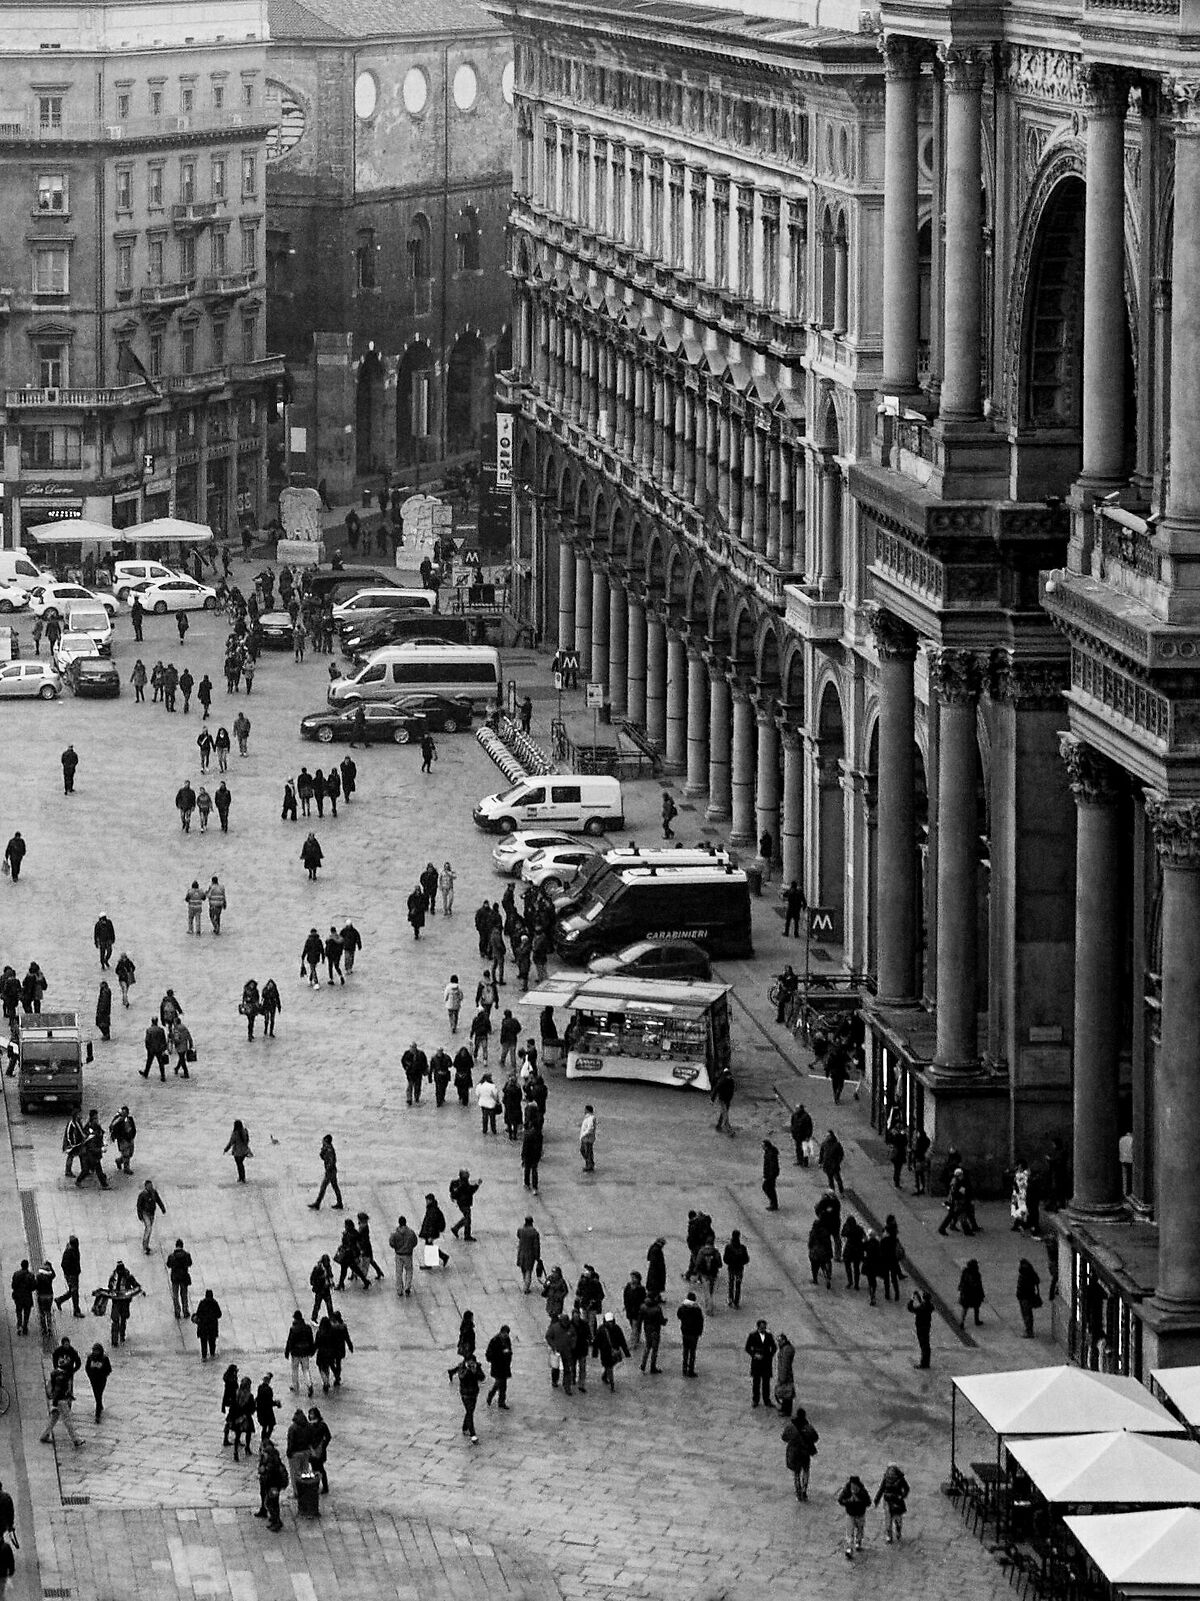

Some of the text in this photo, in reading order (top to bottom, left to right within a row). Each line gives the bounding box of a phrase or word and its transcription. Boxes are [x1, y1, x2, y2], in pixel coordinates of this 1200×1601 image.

[465, 552, 479, 563] M
[562, 656, 578, 668] M
[812, 914, 833, 930] M
[646, 930, 708, 940] CARABINIERI
